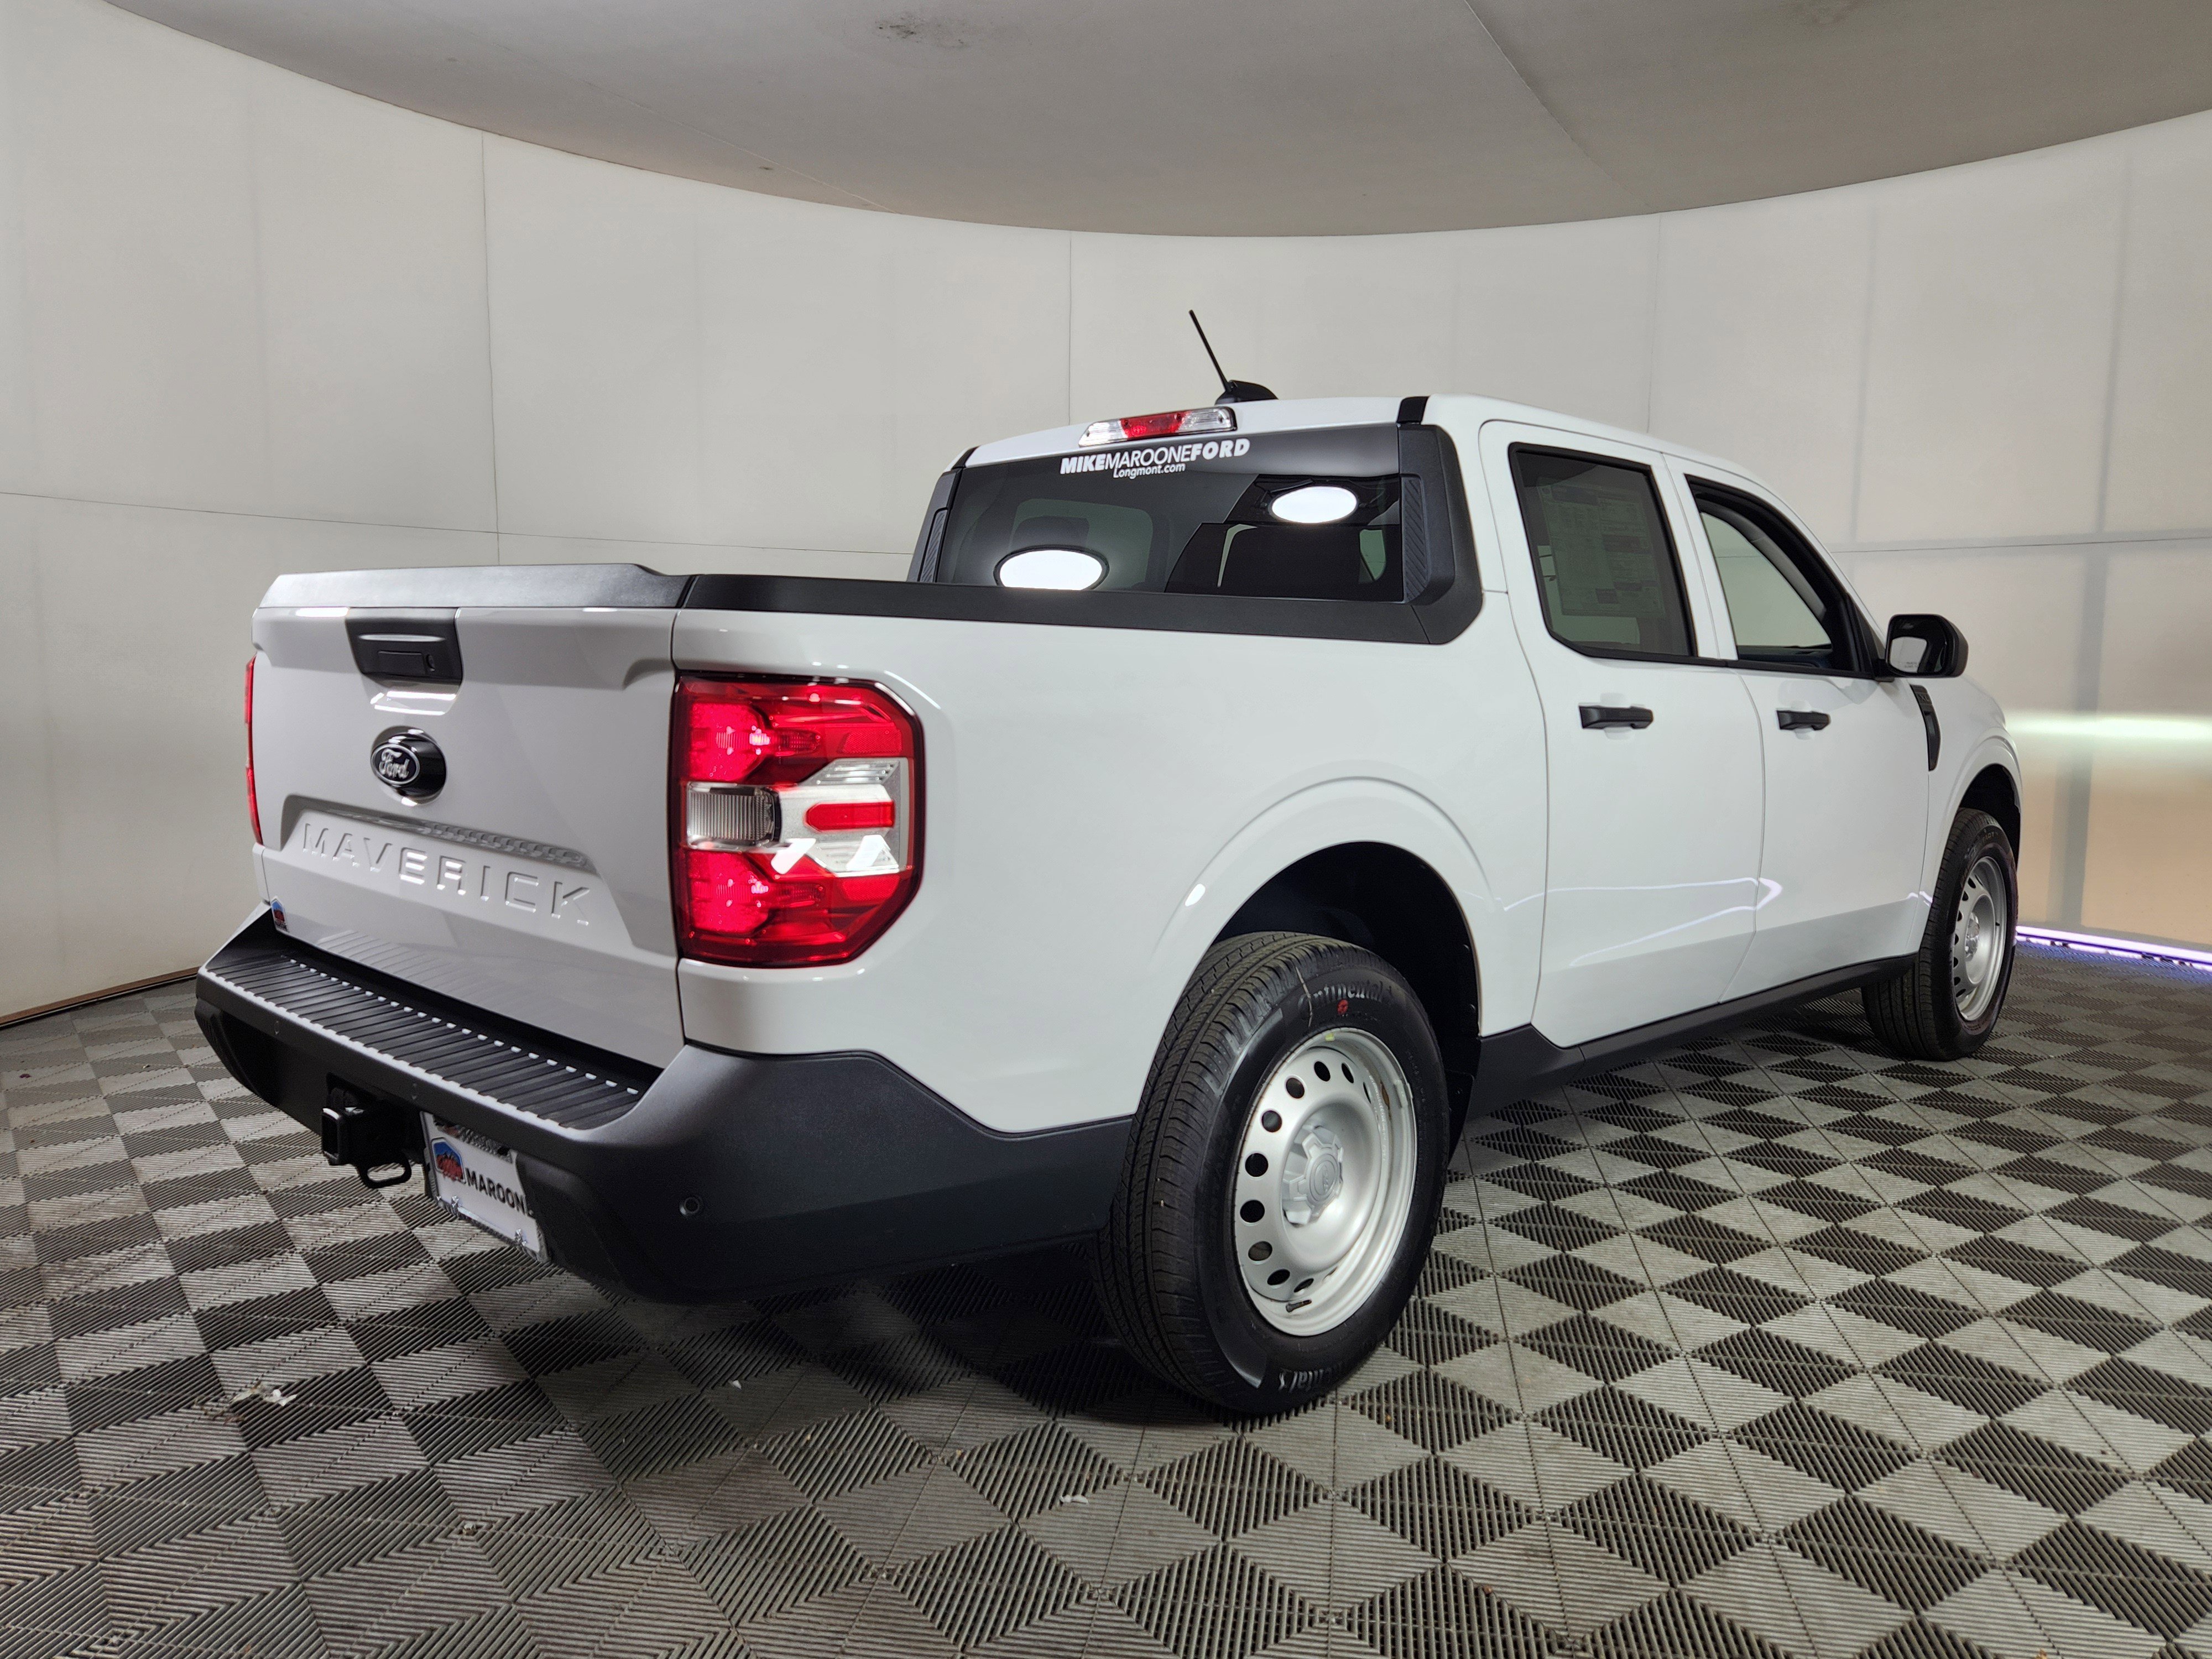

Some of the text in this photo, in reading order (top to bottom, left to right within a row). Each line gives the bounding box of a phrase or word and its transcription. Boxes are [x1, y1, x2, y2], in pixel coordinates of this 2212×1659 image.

[1113, 462, 1186, 479] Longmont.com
[379, 748, 410, 779] Ford
[304, 823, 590, 926] MAVERICK
